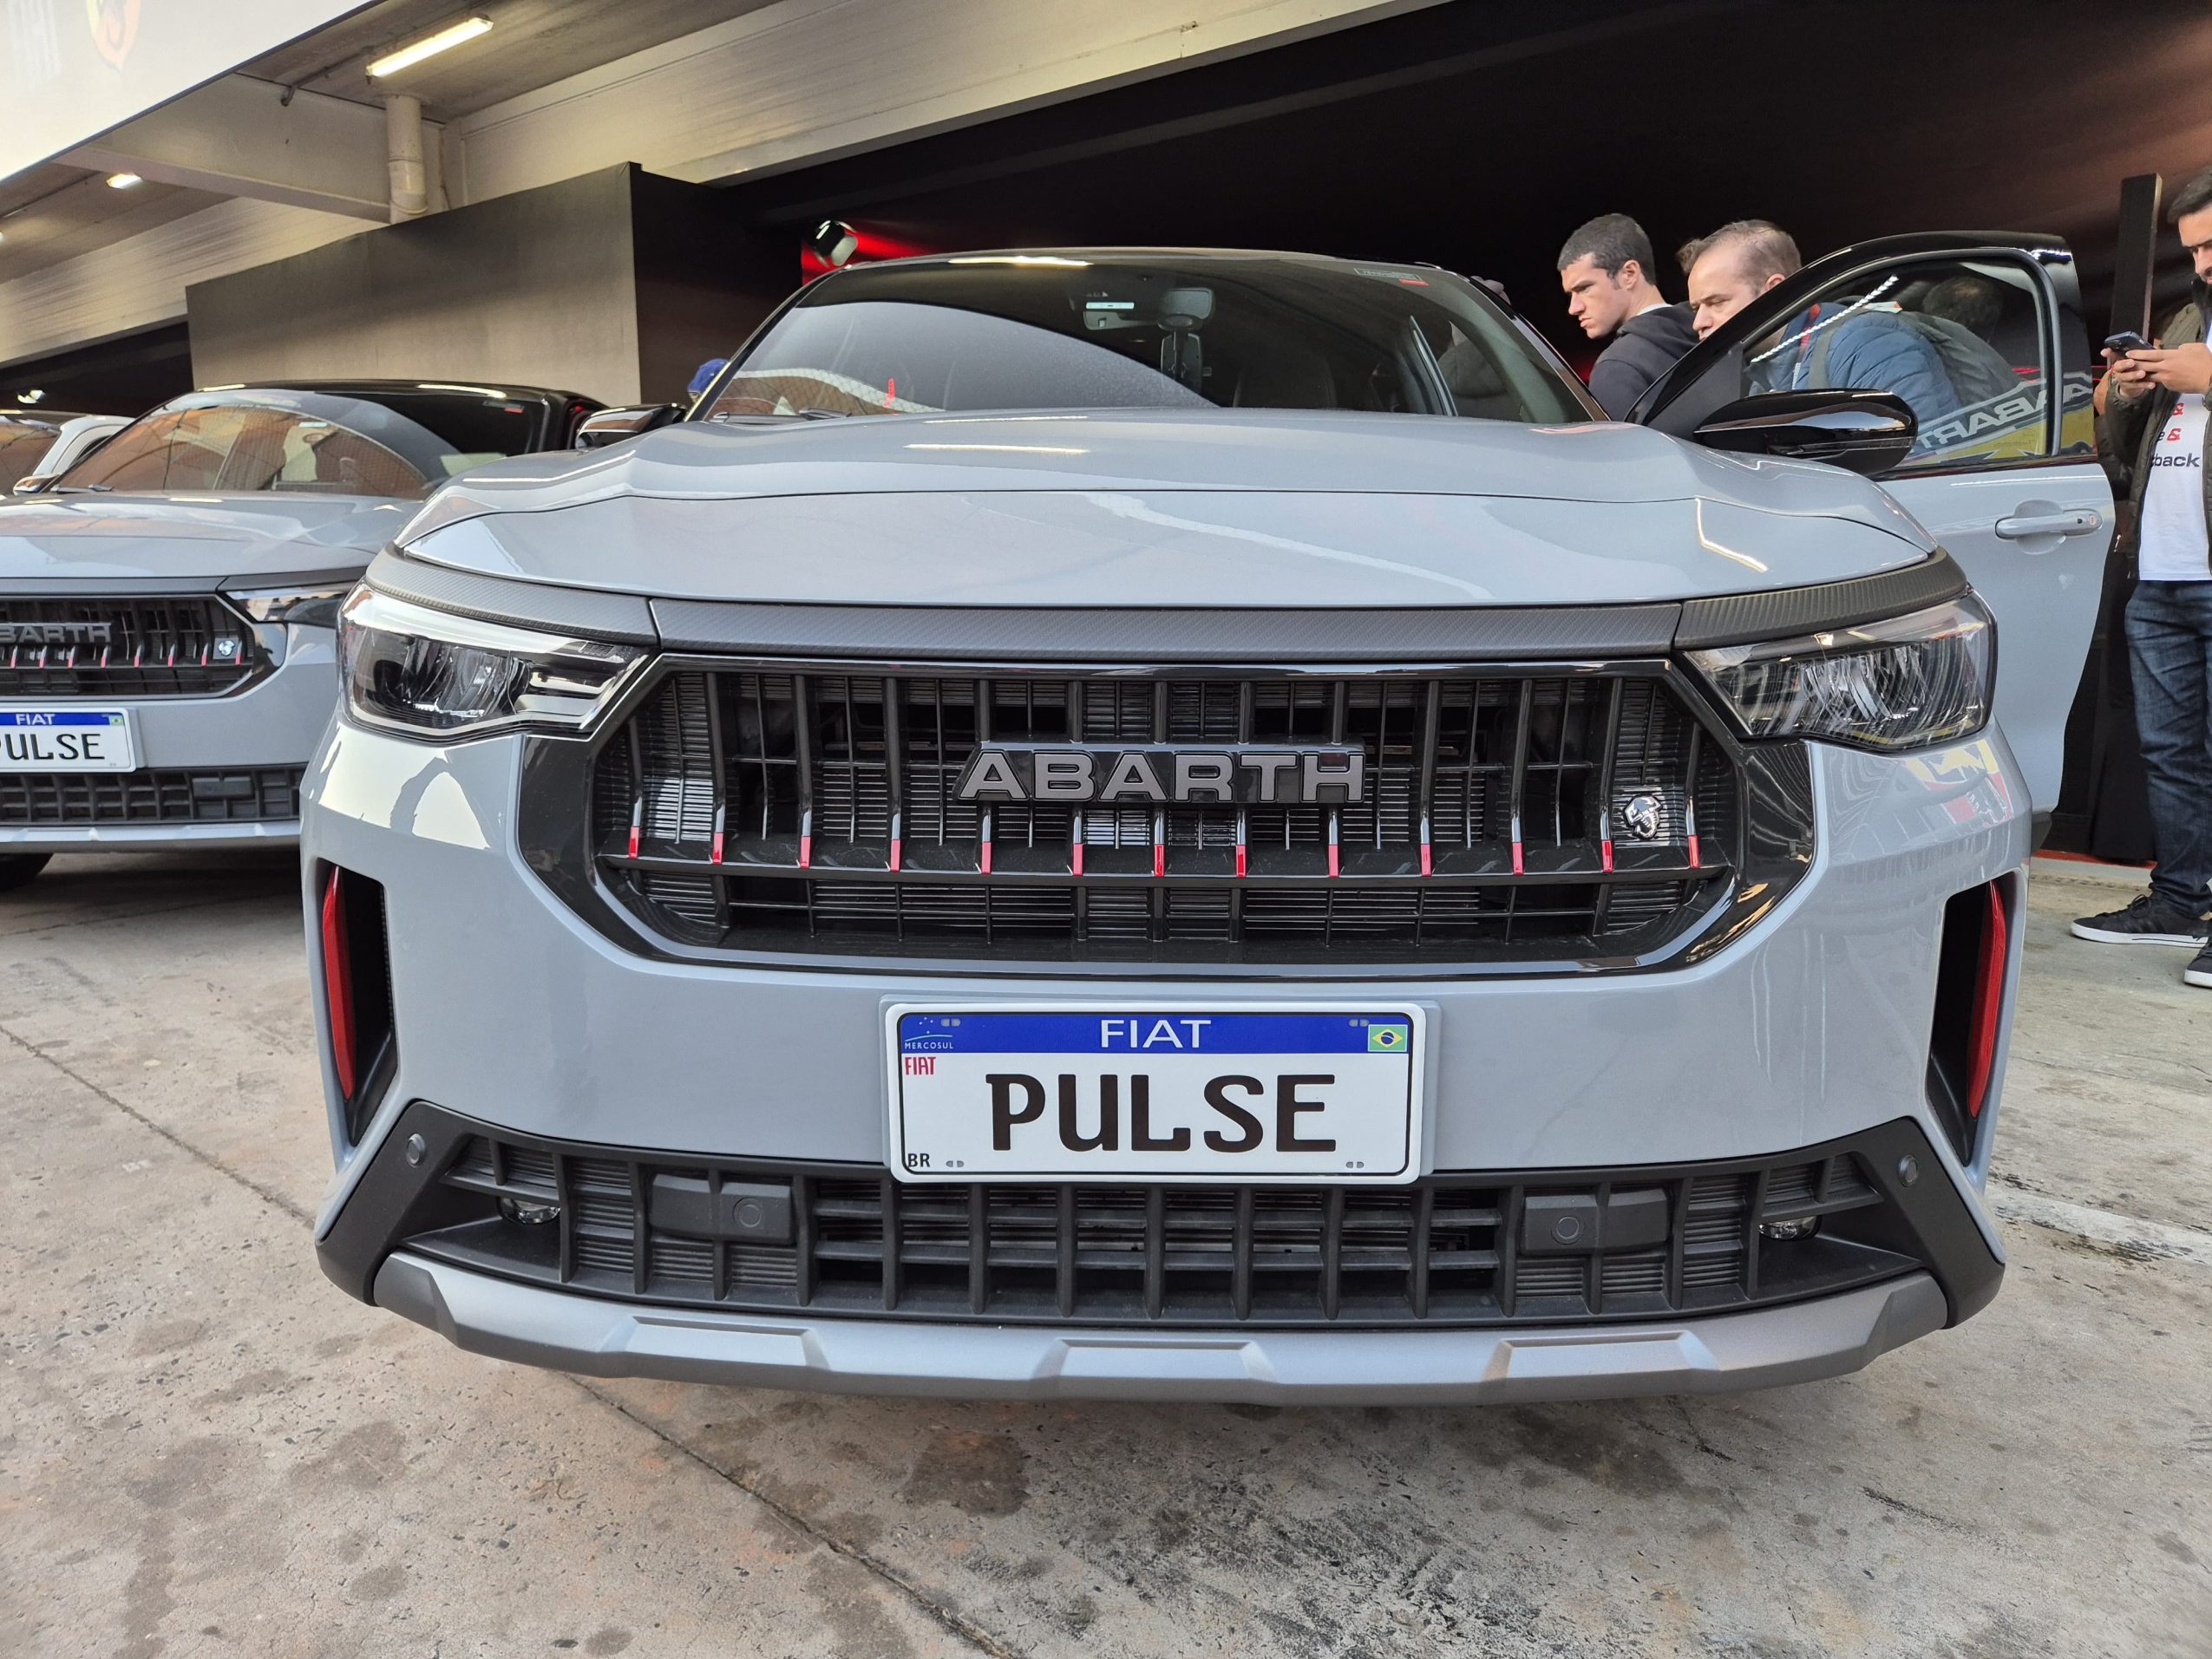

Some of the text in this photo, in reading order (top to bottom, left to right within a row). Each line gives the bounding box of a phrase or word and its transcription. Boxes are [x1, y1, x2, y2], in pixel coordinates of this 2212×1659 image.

[16, 713, 56, 726] FIAT
[0, 734, 105, 761] ULSE
[958, 749, 1365, 803] ABARTH
[1100, 1019, 1212, 1048] FIAT
[904, 1056, 937, 1075] FIAT
[985, 1074, 1337, 1153] PULSE
[907, 1153, 931, 1168] BR
